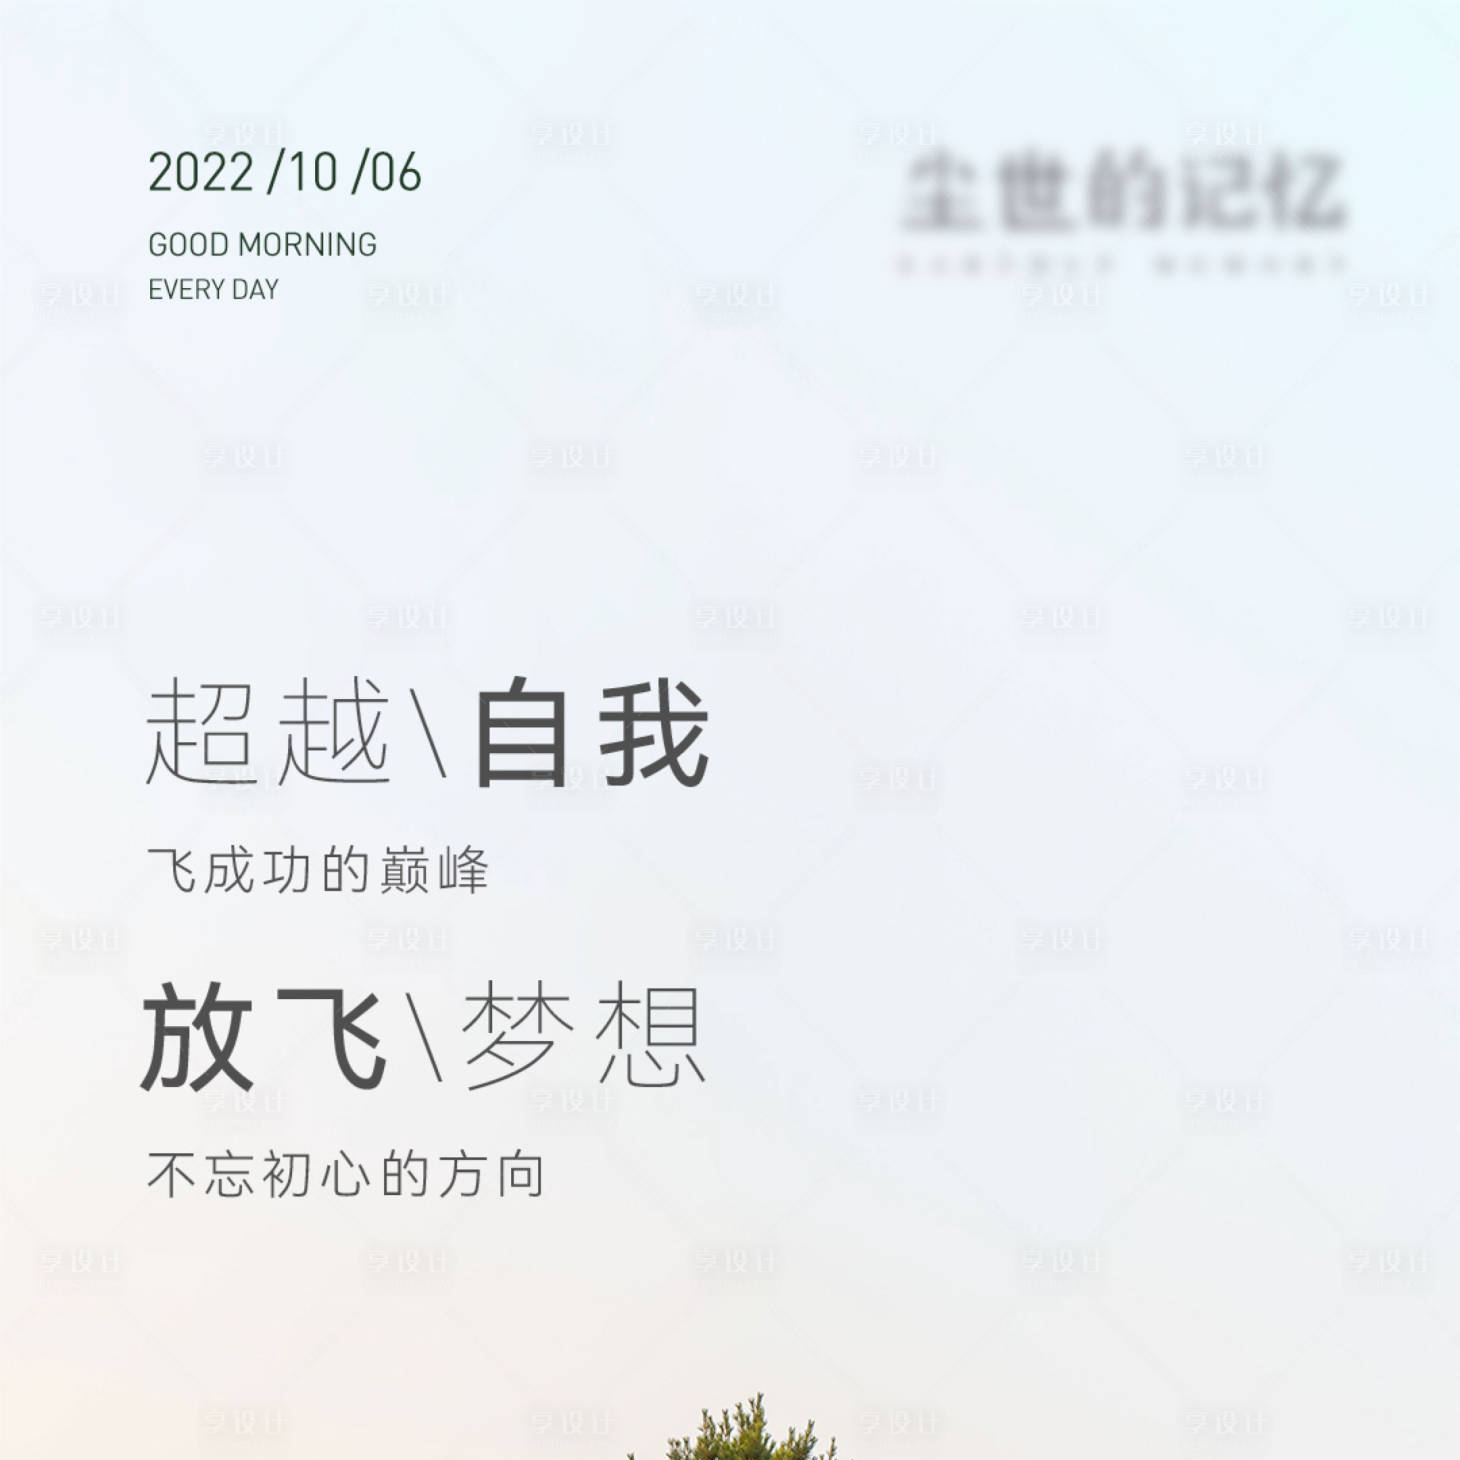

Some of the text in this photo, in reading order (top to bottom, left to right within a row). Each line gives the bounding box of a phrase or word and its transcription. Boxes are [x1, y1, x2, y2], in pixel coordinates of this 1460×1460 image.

[149, 146, 422, 196] 2022 /10 /06
[149, 231, 377, 257] GOOD MORNING
[149, 278, 279, 300] EVERY DAY
[147, 844, 489, 895] 飞成功的巅峰
[147, 1148, 542, 1199] 不忘初心的方向
